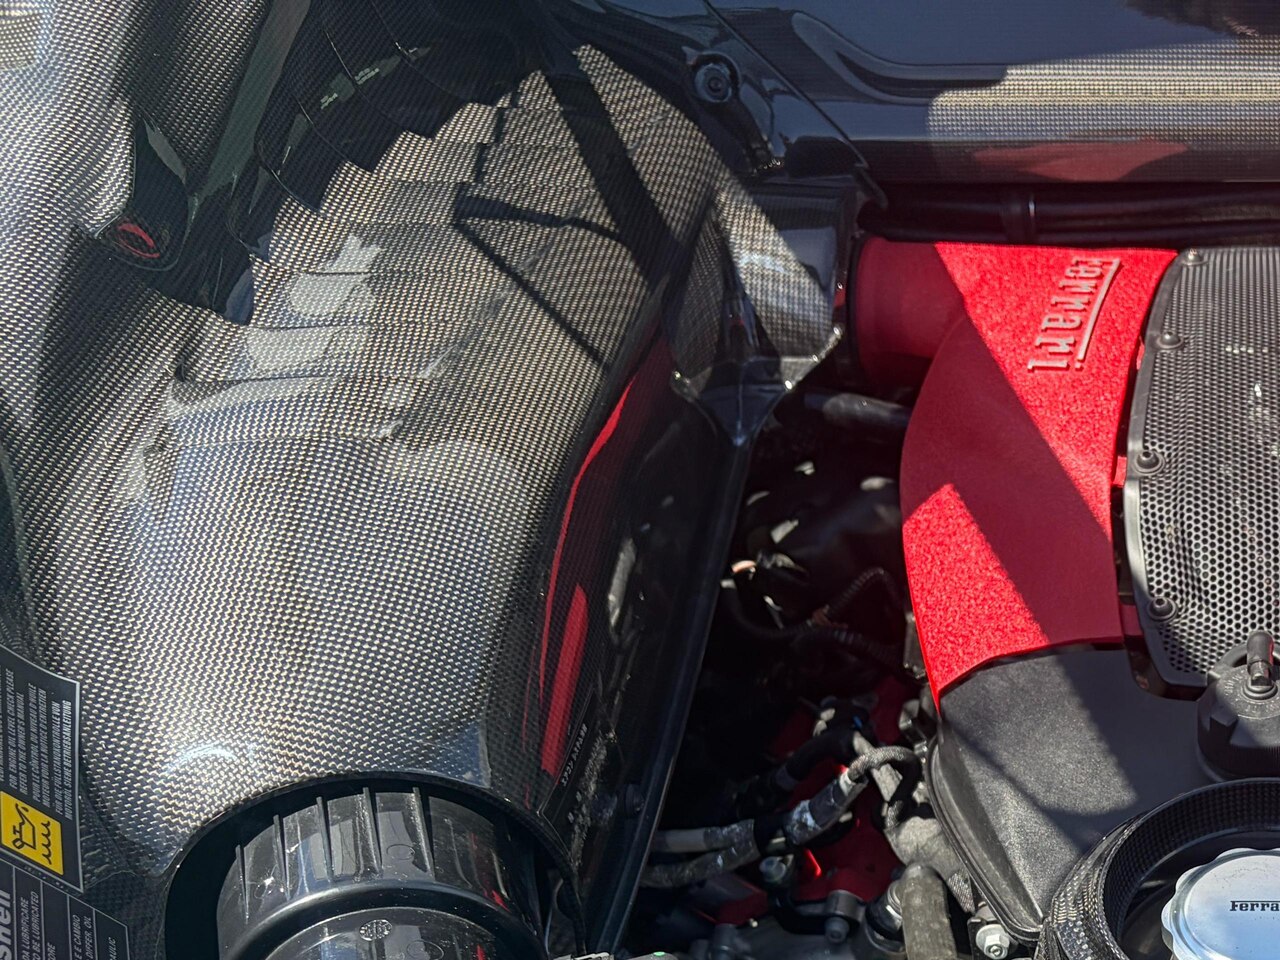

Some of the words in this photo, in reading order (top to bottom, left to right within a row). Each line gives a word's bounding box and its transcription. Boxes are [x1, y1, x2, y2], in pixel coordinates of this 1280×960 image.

[1027, 255, 1121, 371] Ferrari
[6, 668, 14, 694] PLEASE
[6, 693, 15, 716] CHECK
[16, 692, 24, 720] MANUAL
[51, 701, 60, 715] VON
[7, 716, 15, 736] LEVEL
[29, 708, 37, 733] NIVEAU
[8, 736, 16, 747] OIL
[30, 732, 38, 744] DU
[40, 730, 48, 754] NOTICE
[62, 700, 72, 767] BETRIEBSANLEITUNG
[8, 746, 17, 773] ENGINE
[18, 749, 27, 763] THE
[41, 754, 48, 763] LA
[19, 763, 27, 772] TO
[32, 773, 40, 782] LE
[41, 763, 49, 779] VOIR
[63, 767, 72, 788] SIEHE
[9, 774, 17, 789] FOR
[19, 772, 27, 795] REFER
[32, 782, 40, 802] POUR
[42, 779, 50, 807] MOTEUR
[54, 788, 62, 800] DIE
[52, 800, 63, 815] FÜR
[62, 788, 72, 820] MOTORÖL
[21, 897, 30, 949] LUBRIFICARE
[31, 891, 40, 939] LUBRICATED
[83, 916, 92, 928] OIL
[73, 914, 81, 945] CAMBIO
[32, 940, 40, 952] BE
[85, 931, 94, 959] DIFFER.
